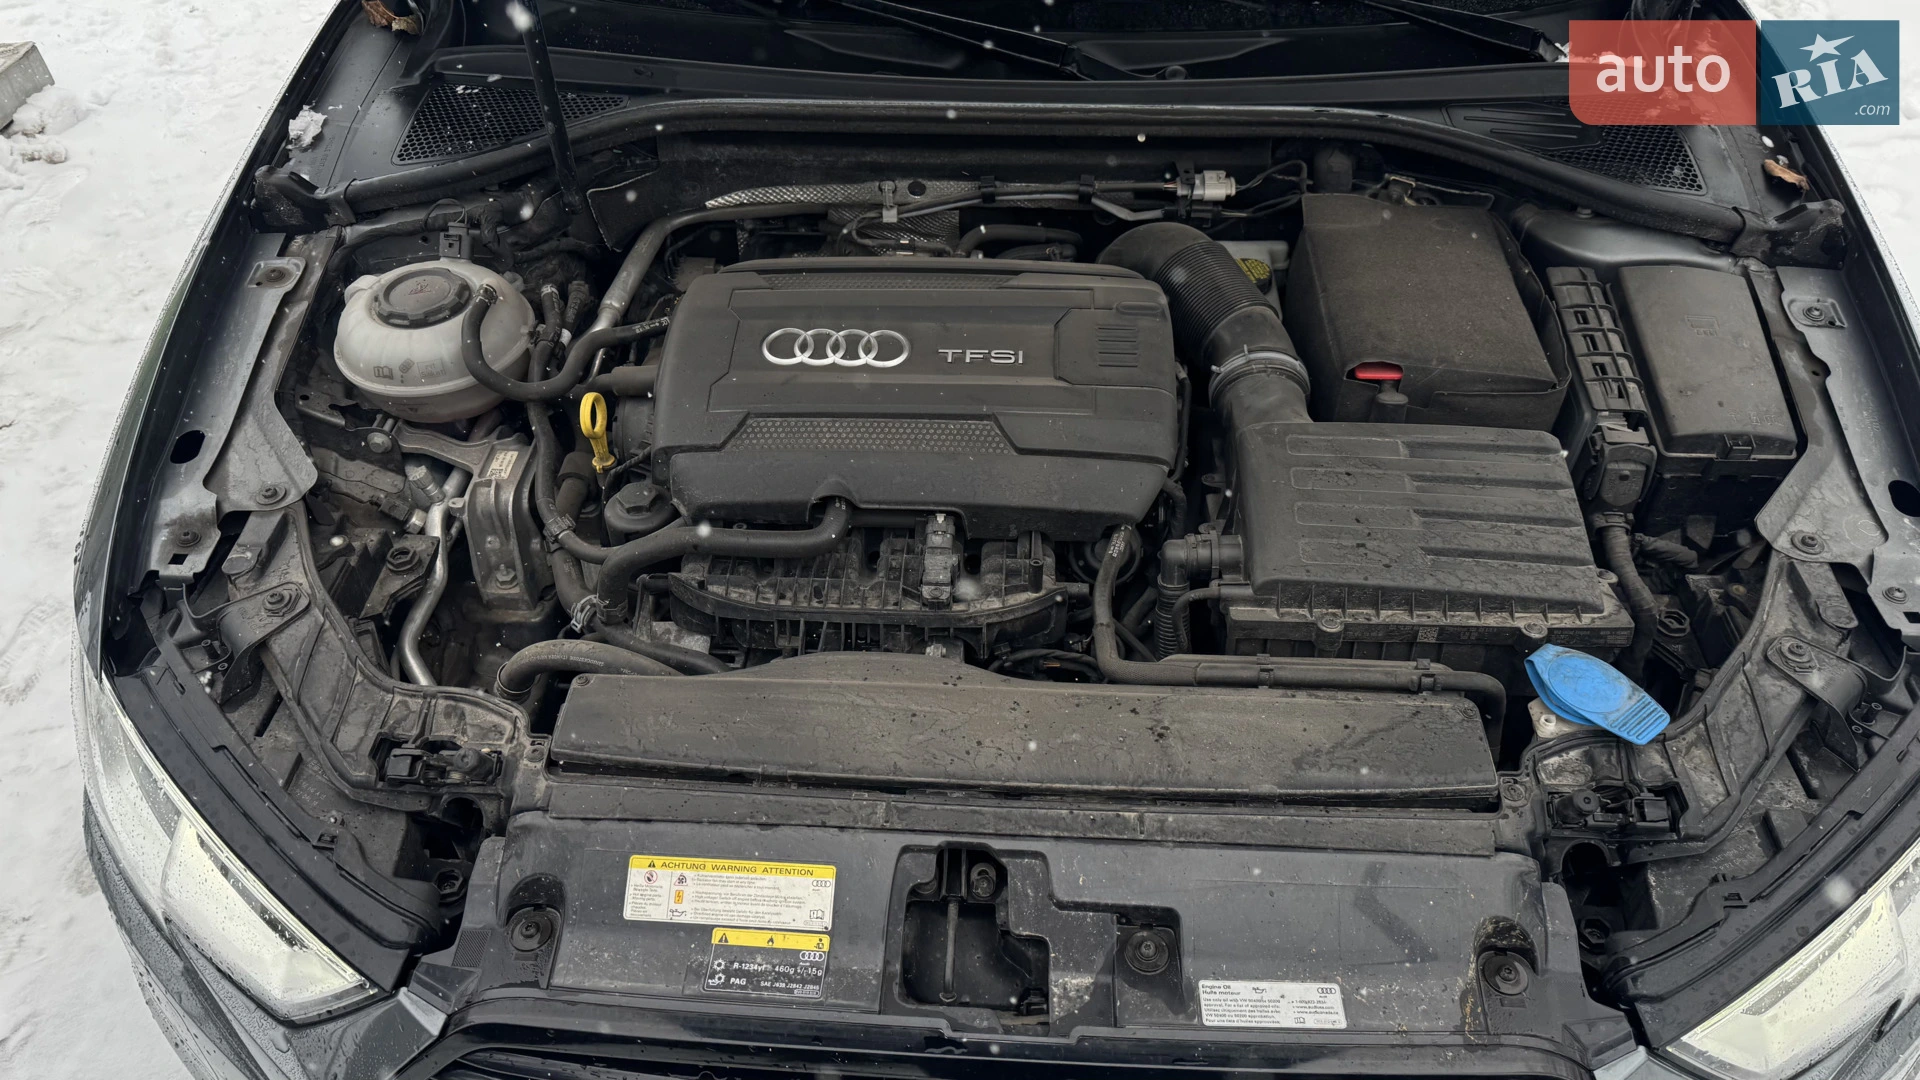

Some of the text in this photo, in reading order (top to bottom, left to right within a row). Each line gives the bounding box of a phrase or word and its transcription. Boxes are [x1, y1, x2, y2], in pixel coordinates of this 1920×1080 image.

[938, 349, 1024, 364] TFSI
[661, 861, 814, 876] ACHTUNG WARNING ATTENTION
[733, 963, 765, 971] R-1234yf
[775, 965, 795, 974] 460g
